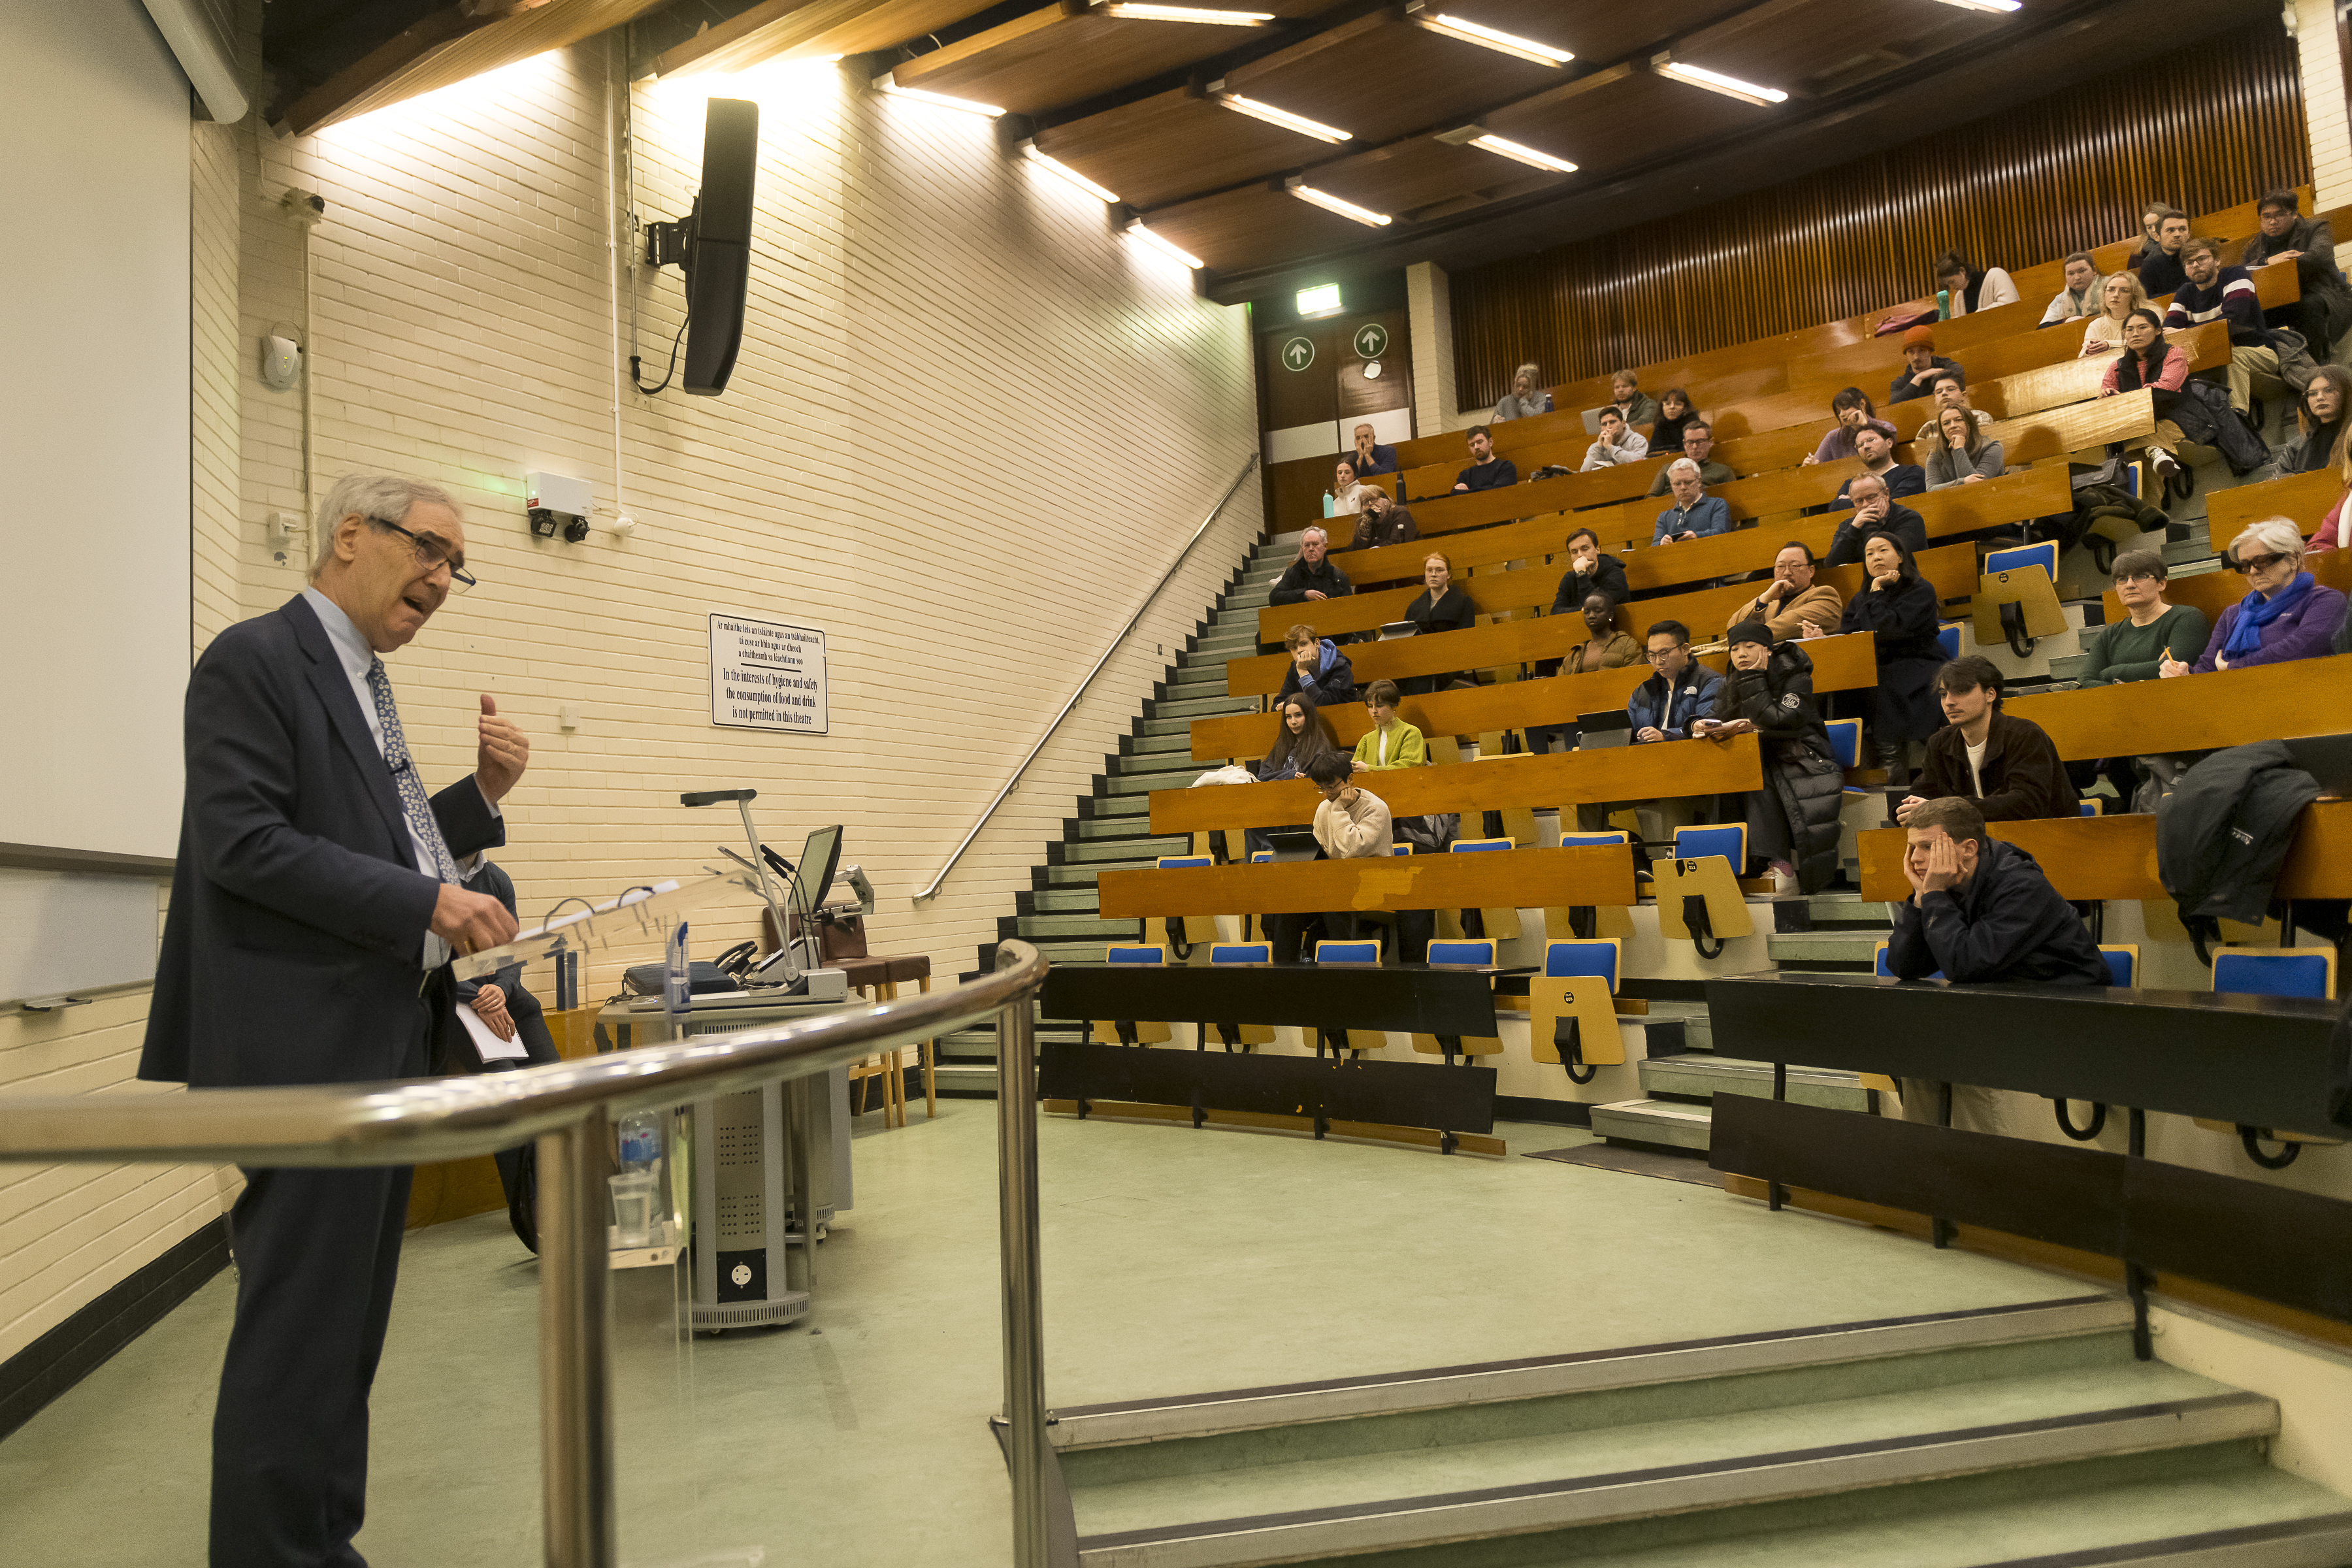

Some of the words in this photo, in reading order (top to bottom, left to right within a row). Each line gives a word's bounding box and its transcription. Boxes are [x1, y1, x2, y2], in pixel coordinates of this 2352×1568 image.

[717, 621, 723, 629] Ar
[723, 622, 742, 632] mhaithe
[758, 627, 774, 637] tsláinte
[775, 632, 784, 640] agus
[739, 636, 743, 645] tá
[760, 640, 770, 649] bhia
[772, 642, 781, 651] agus
[787, 644, 802, 653] dheoch
[742, 649, 768, 661] chaitheamh
[774, 653, 796, 664] léachtlann
[723, 668, 730, 680] In
[731, 669, 740, 681] the
[741, 670, 764, 685] interests
[766, 673, 771, 685] of
[772, 674, 792, 689] hygiene
[792, 678, 802, 689] and
[804, 678, 817, 693] safety
[727, 687, 735, 699] the
[736, 690, 771, 705] consumption
[772, 693, 778, 704] of
[779, 692, 791, 705] food
[791, 694, 801, 706] and
[802, 694, 816, 707] drink
[732, 706, 738, 718] is
[739, 708, 748, 719] not
[749, 708, 775, 722] permitted
[776, 710, 782, 722] in
[783, 710, 792, 723] this
[794, 712, 811, 725] theatre
